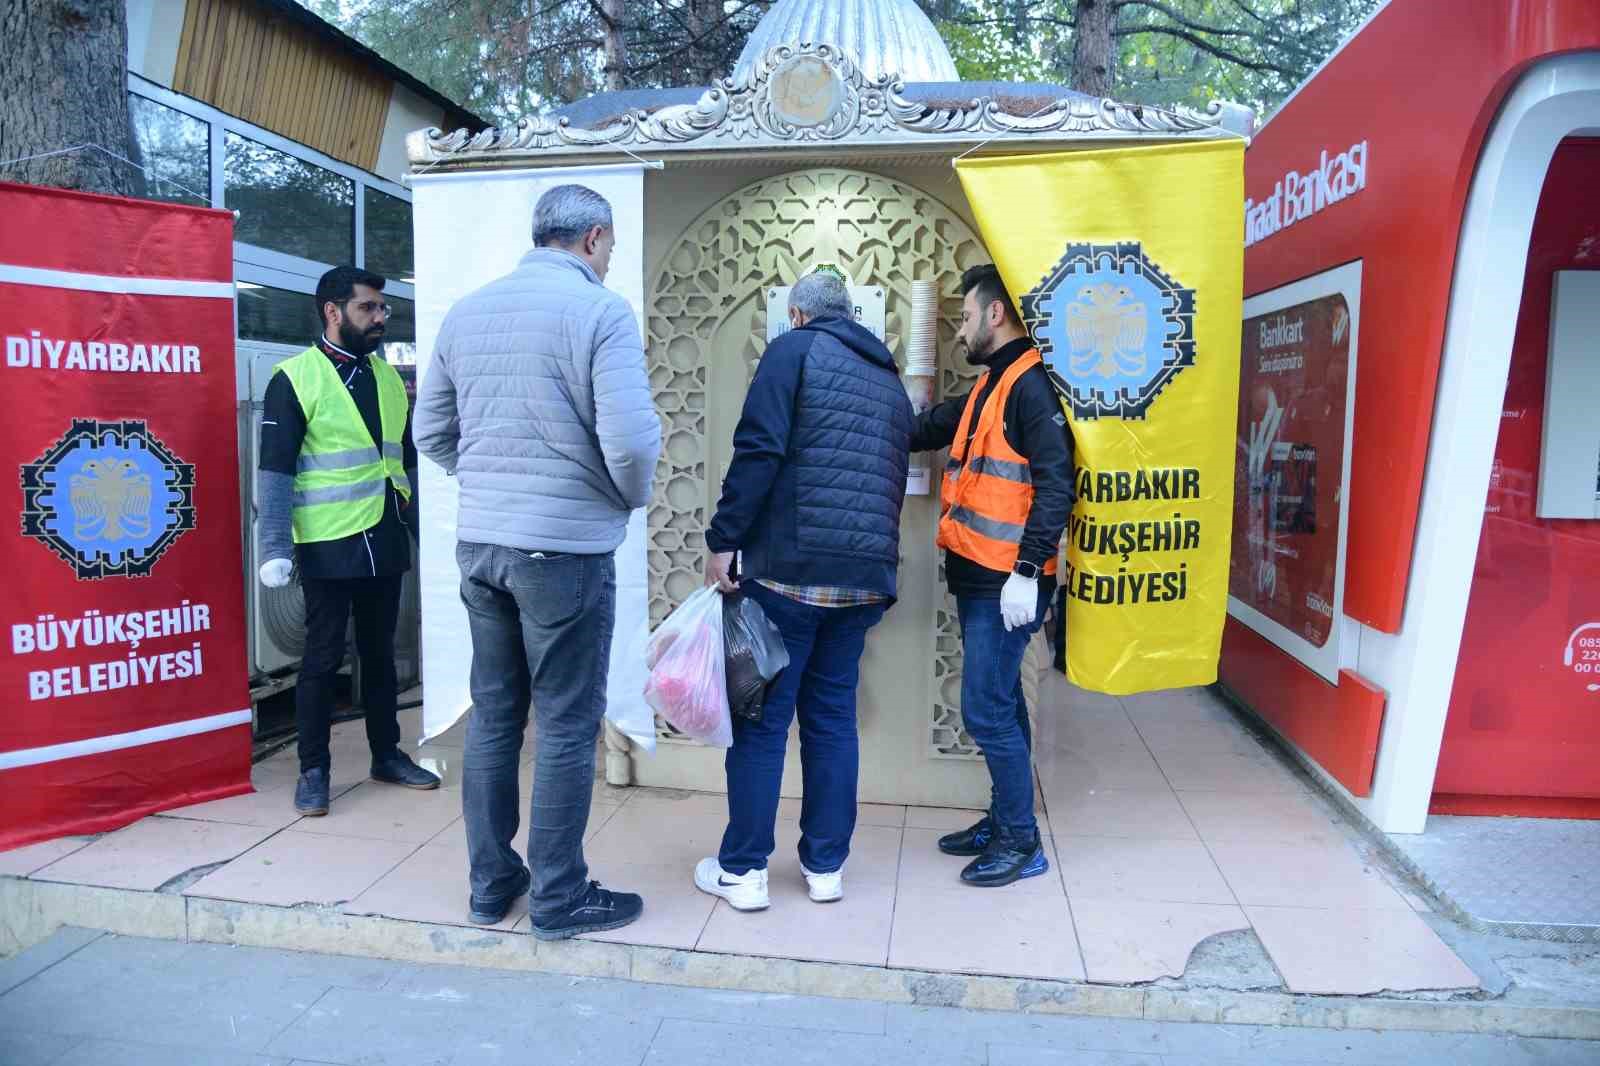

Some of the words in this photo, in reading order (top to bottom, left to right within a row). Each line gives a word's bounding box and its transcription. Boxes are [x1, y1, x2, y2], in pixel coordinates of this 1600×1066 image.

[1283, 139, 1368, 228] Bankası
[6, 331, 201, 375] DİYARBAKIR
[1259, 315, 1303, 350] Bankkart
[1067, 513, 1201, 563] YÜKŞEHİR
[11, 600, 212, 655] BÜYÜKŞEHİR
[28, 641, 204, 701] BELEDİYESİ
